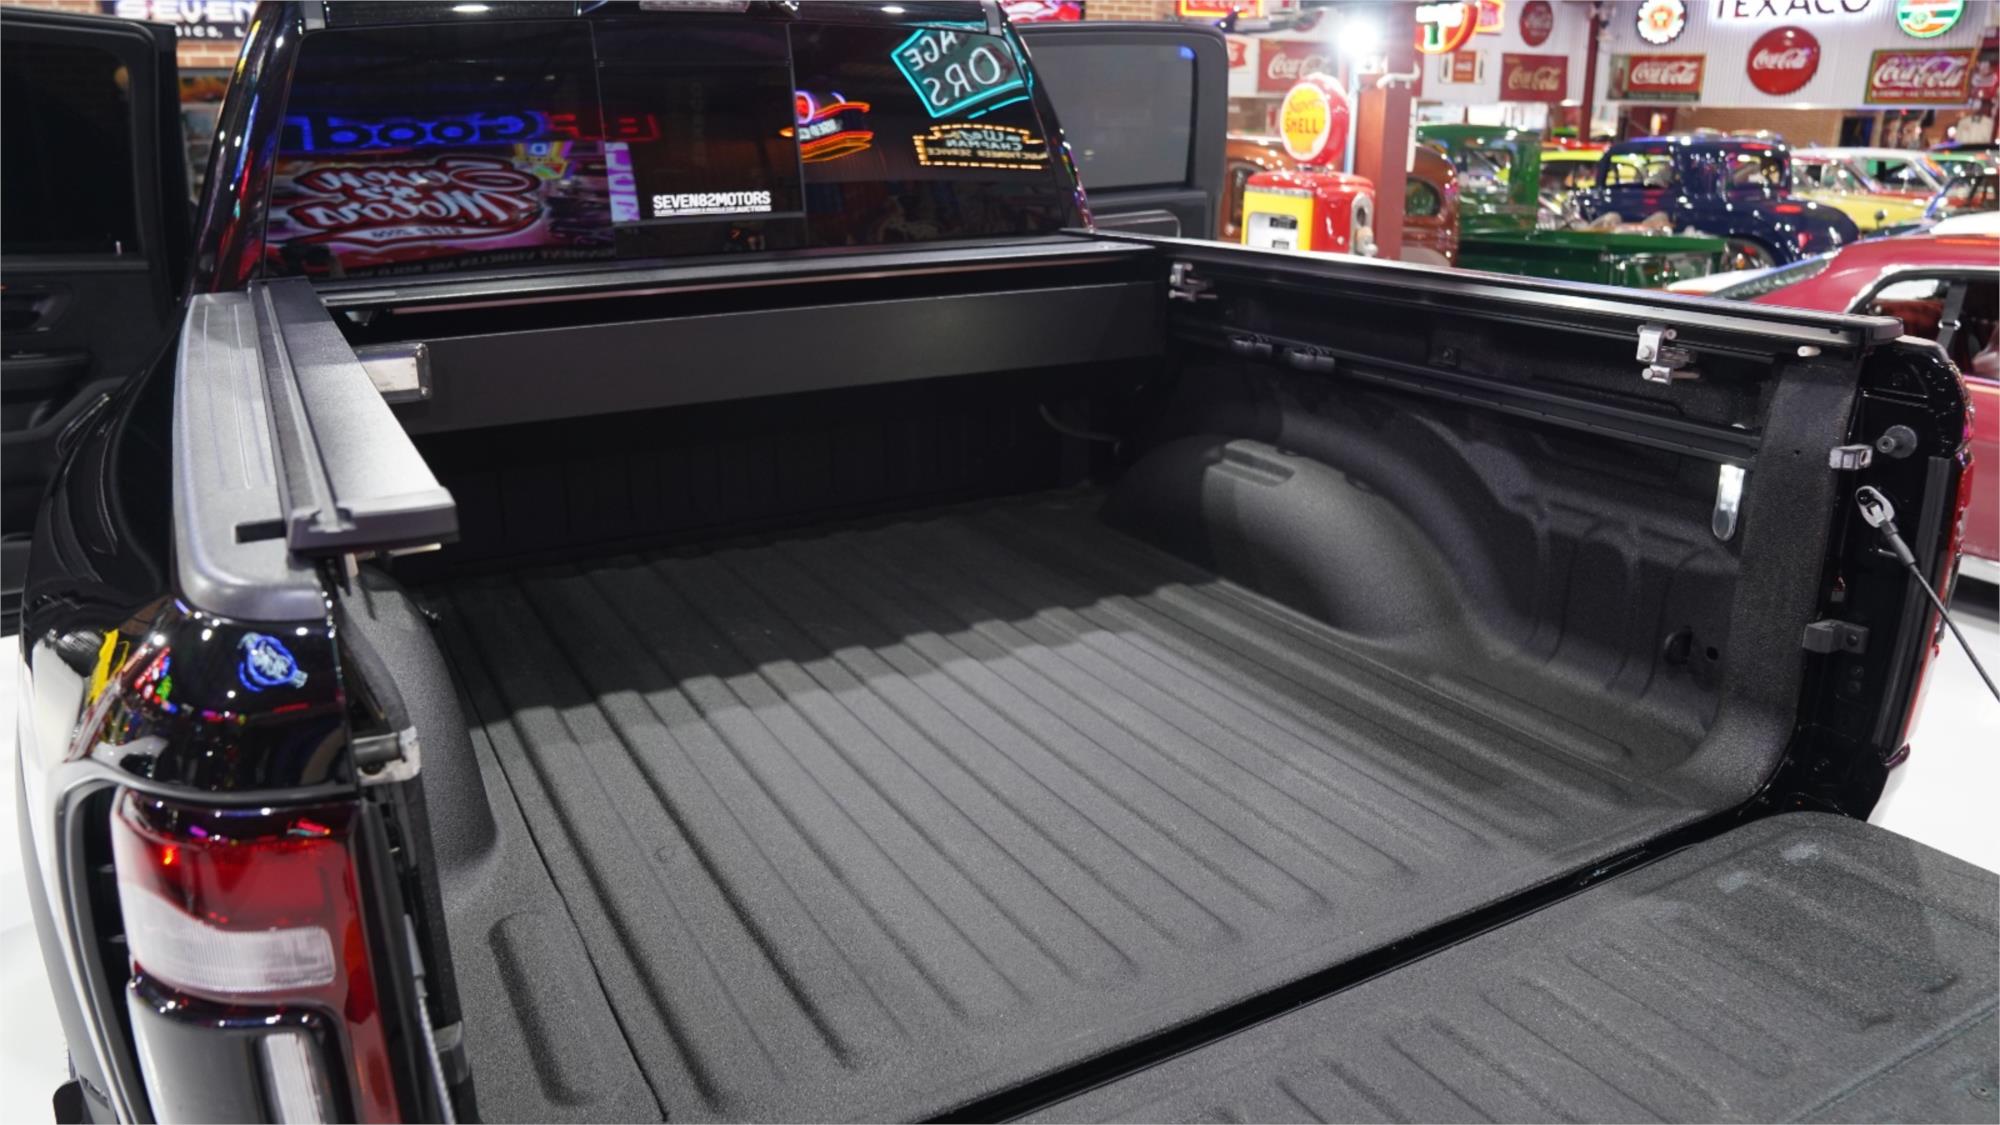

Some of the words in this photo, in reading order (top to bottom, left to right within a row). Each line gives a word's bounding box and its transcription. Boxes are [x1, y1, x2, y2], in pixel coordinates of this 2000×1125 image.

[1267, 52, 1332, 80] Coca-C
[1285, 117, 1319, 134] SHELL
[653, 191, 771, 210] SEVEN82MOTORS
